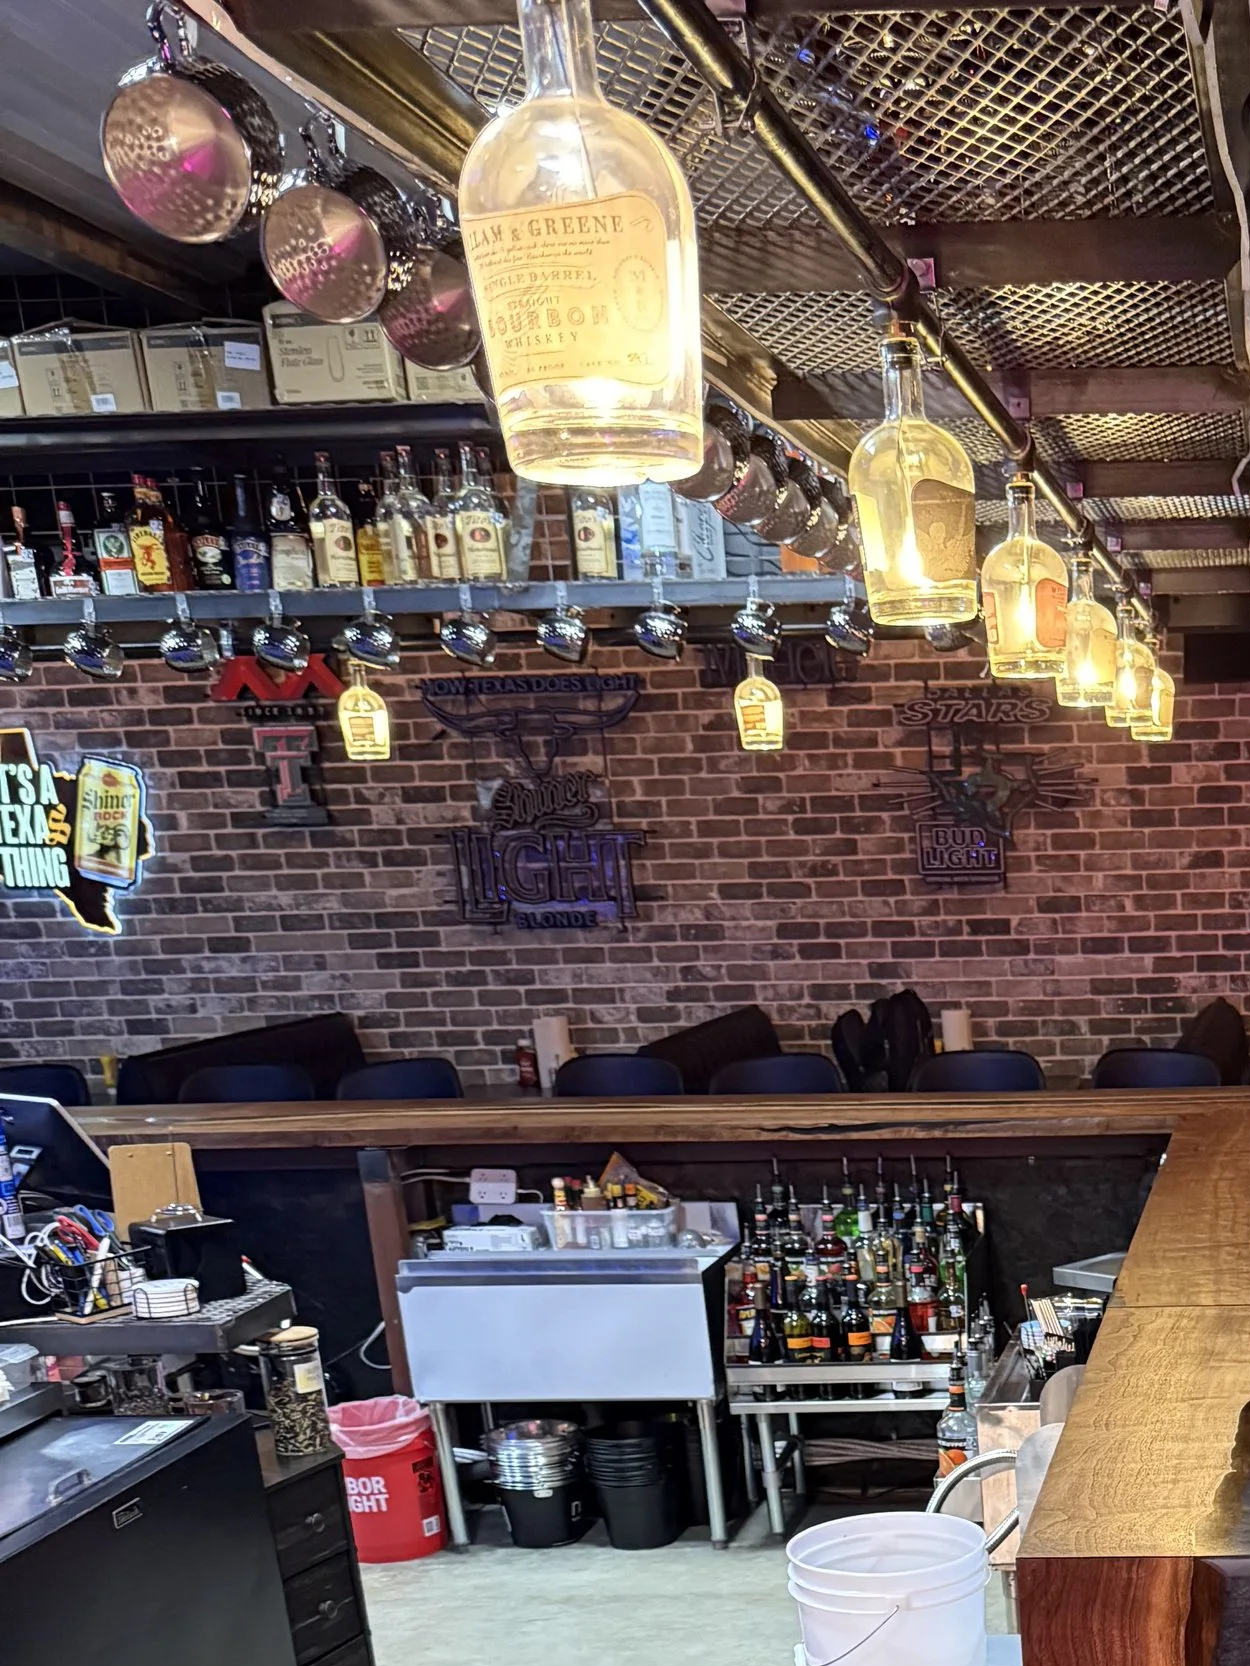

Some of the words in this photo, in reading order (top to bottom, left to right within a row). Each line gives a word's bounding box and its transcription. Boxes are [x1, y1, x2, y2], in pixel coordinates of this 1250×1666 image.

[511, 228, 523, 243] &
[527, 214, 624, 238] GREENE
[504, 330, 579, 350] WHISKEY
[472, 676, 529, 694] TEXAS
[532, 675, 581, 692] DOES
[585, 674, 637, 691] LIGHT
[926, 687, 1032, 699] DALLAS
[900, 697, 1052, 725] STARS
[0, 763, 36, 805] T'S
[40, 763, 59, 805] A
[81, 788, 136, 812] Shiner
[0, 803, 72, 846] EXAS
[932, 828, 987, 848] BUD
[1, 847, 71, 888] THING
[923, 848, 998, 868] LIGHT
[450, 827, 648, 923] LIGHT
[515, 910, 597, 928] BLONDE
[345, 1476, 388, 1495] BOR
[348, 1494, 391, 1514] IGHT
